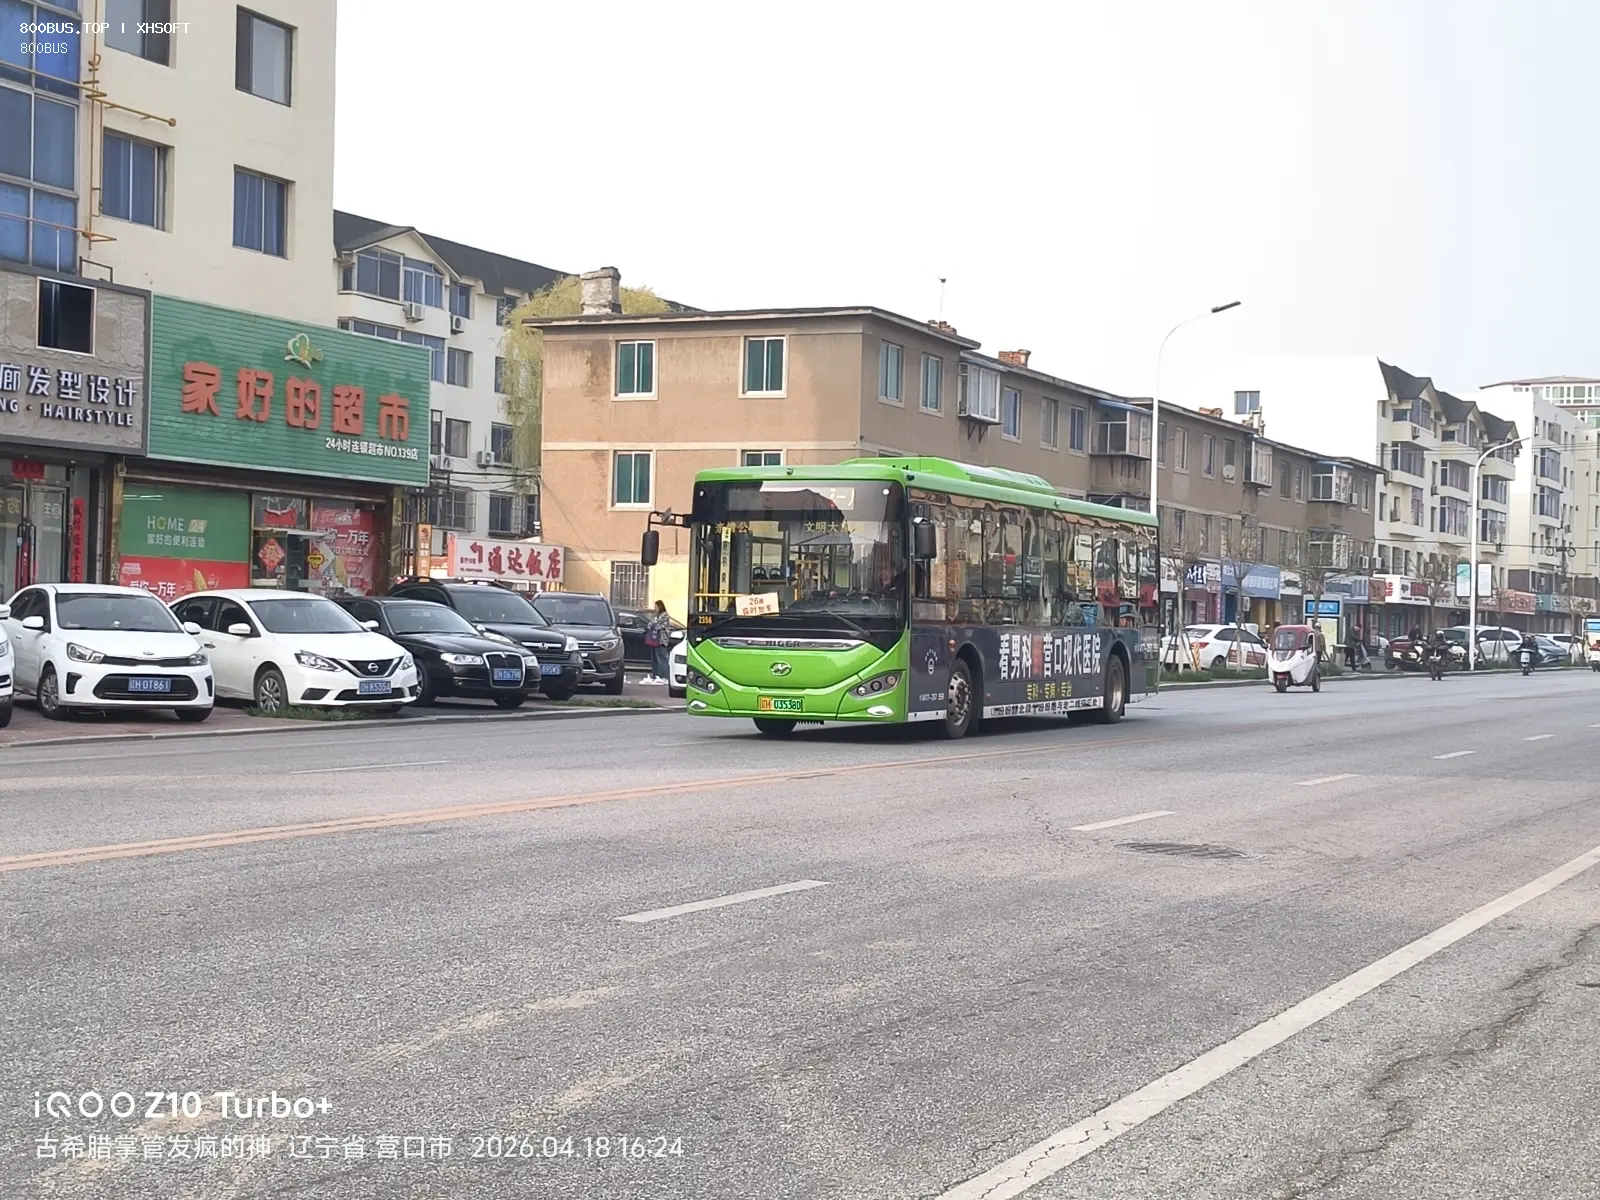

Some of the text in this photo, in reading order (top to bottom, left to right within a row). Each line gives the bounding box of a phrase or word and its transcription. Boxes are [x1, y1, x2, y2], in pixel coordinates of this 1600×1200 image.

[181, 360, 411, 442] 家好的超市
[43, 403, 134, 426] HAIRSTYLE
[147, 516, 184, 532] HOME
[147, 533, 206, 548] 家好的便利连锁
[999, 633, 1032, 680] 看男科
[1043, 632, 1101, 678] 营口现代医院
